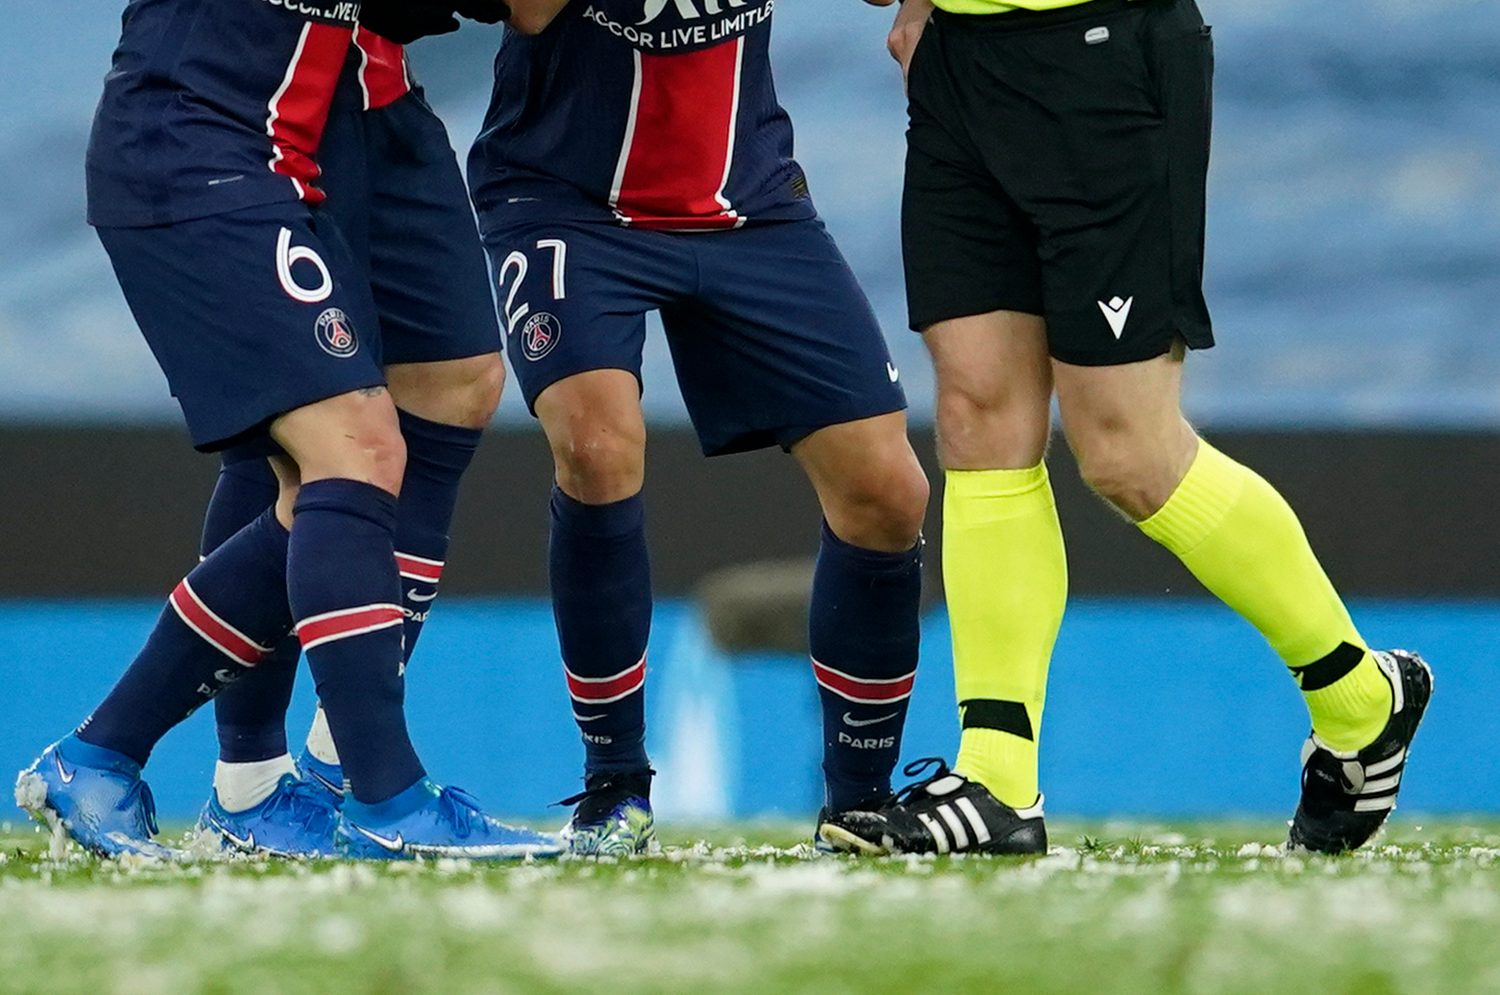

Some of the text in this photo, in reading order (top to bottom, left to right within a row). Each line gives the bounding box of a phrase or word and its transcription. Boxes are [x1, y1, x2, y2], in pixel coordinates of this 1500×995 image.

[583, 5, 653, 48] ACCOR
[660, 26, 707, 48] LIVE
[276, 226, 333, 303] 6
[499, 238, 566, 335] 27
[524, 315, 550, 334] PARIS
[838, 731, 895, 749] PARIS
